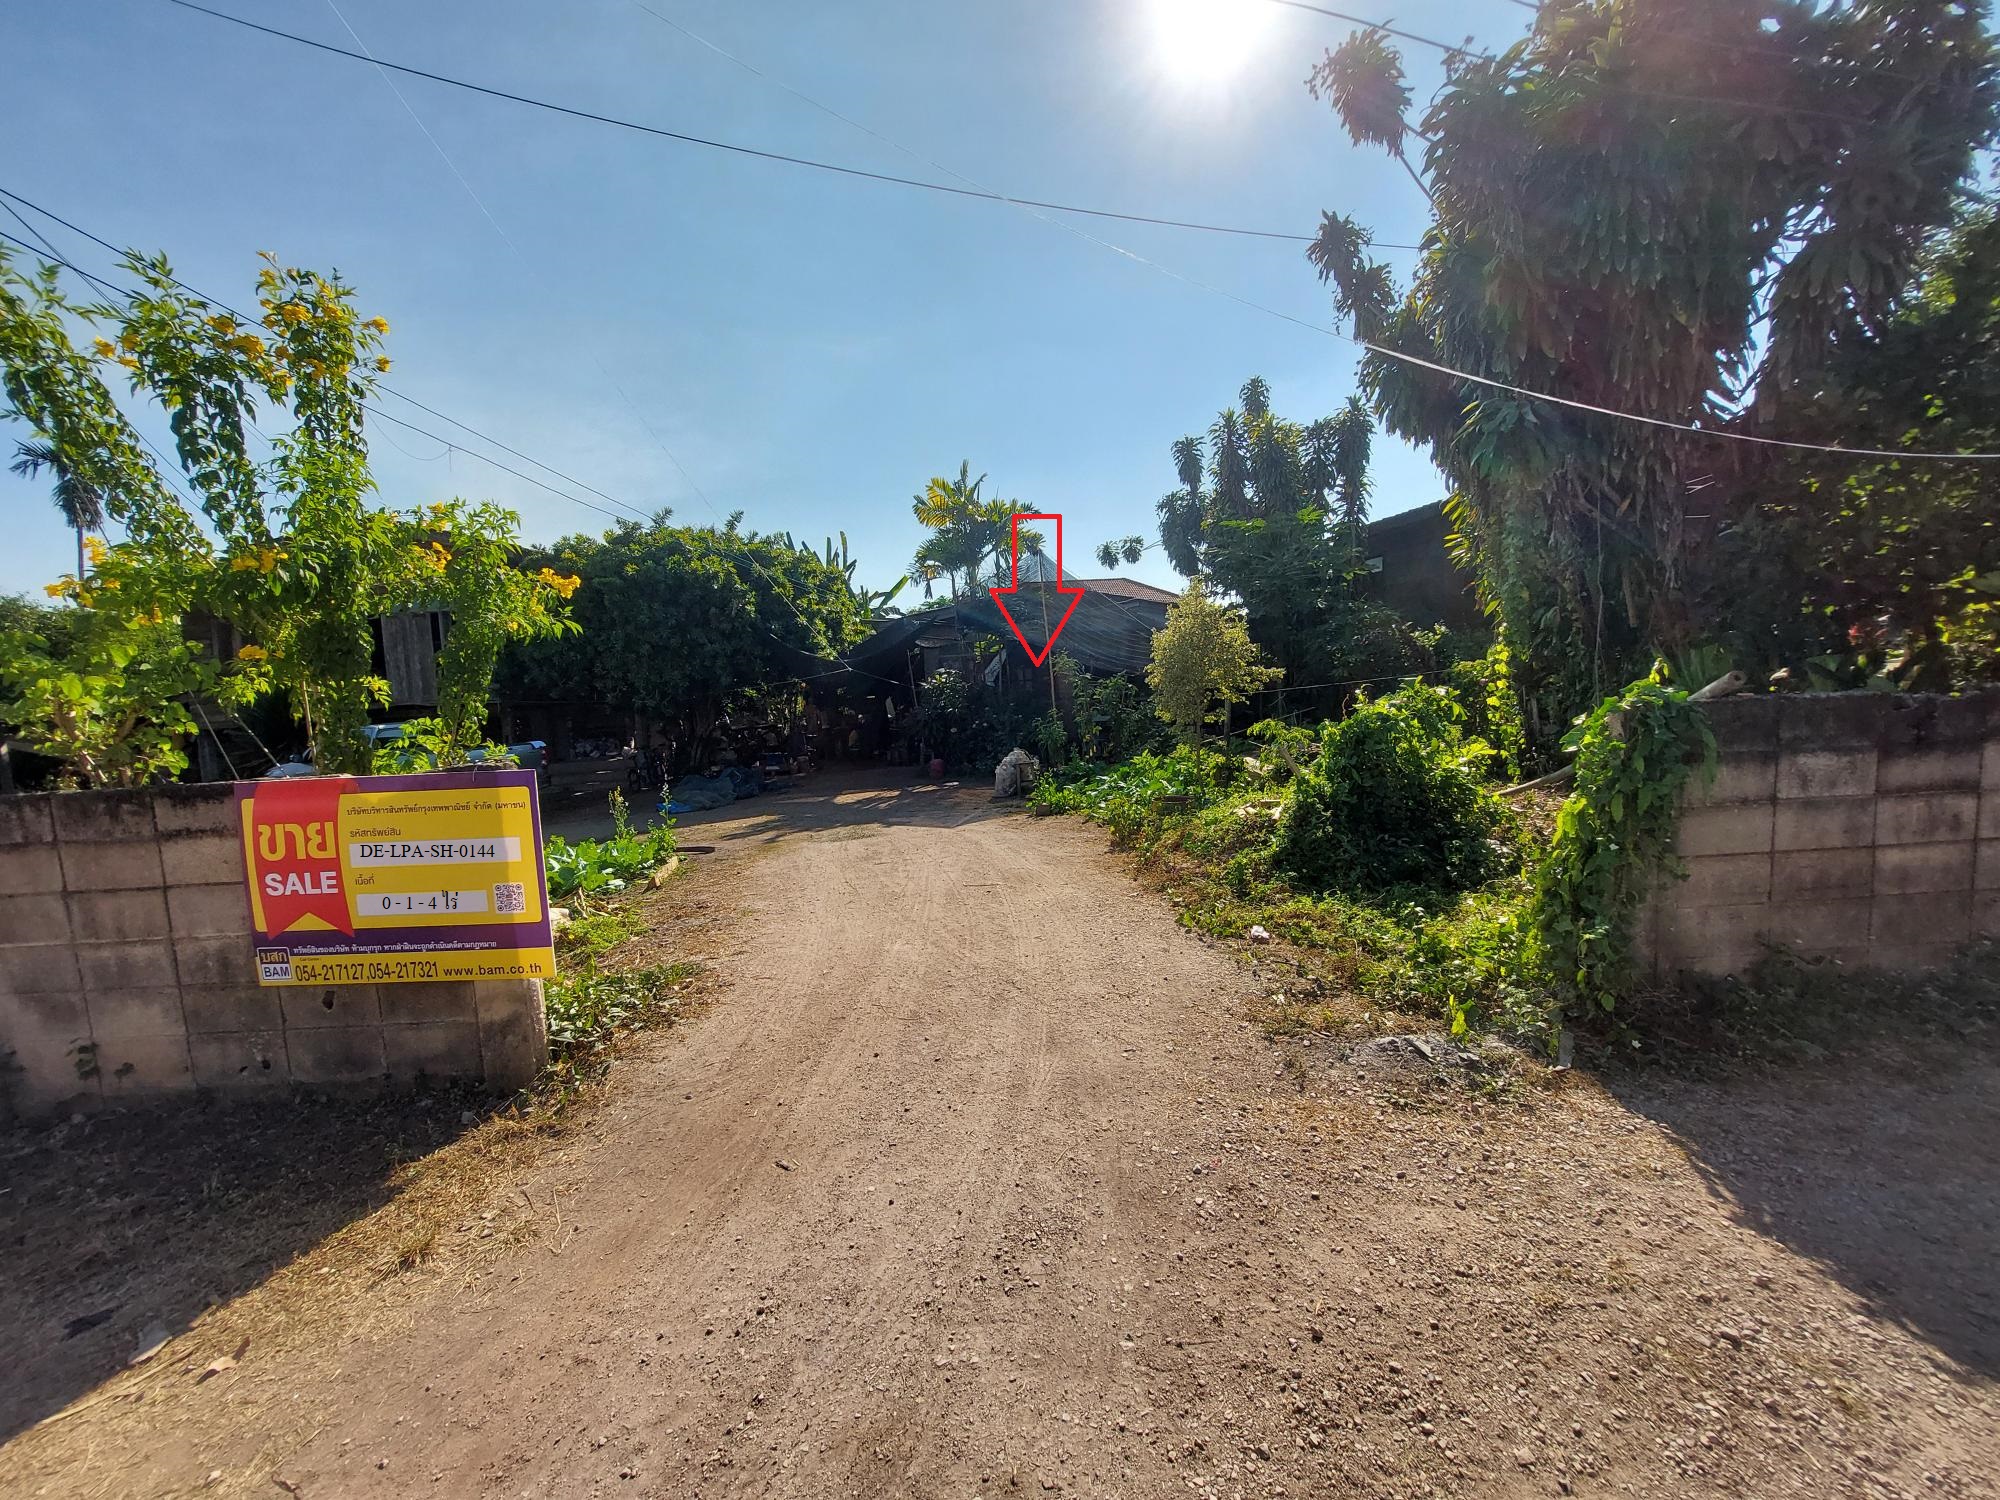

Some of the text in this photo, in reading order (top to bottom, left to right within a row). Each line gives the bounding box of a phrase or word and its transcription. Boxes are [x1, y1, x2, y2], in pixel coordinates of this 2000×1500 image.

[473, 801, 492, 810] จำกัด
[495, 801, 526, 810] (มหาชน)
[349, 827, 401, 838] รหัสทรัพย์สิน
[257, 821, 337, 862] ขาย
[264, 871, 339, 897] SALE
[354, 873, 375, 886] เนื้อที่
[260, 951, 288, 962] บสก
[264, 965, 291, 978] BAM
[443, 962, 542, 977] www.bam.co.th
